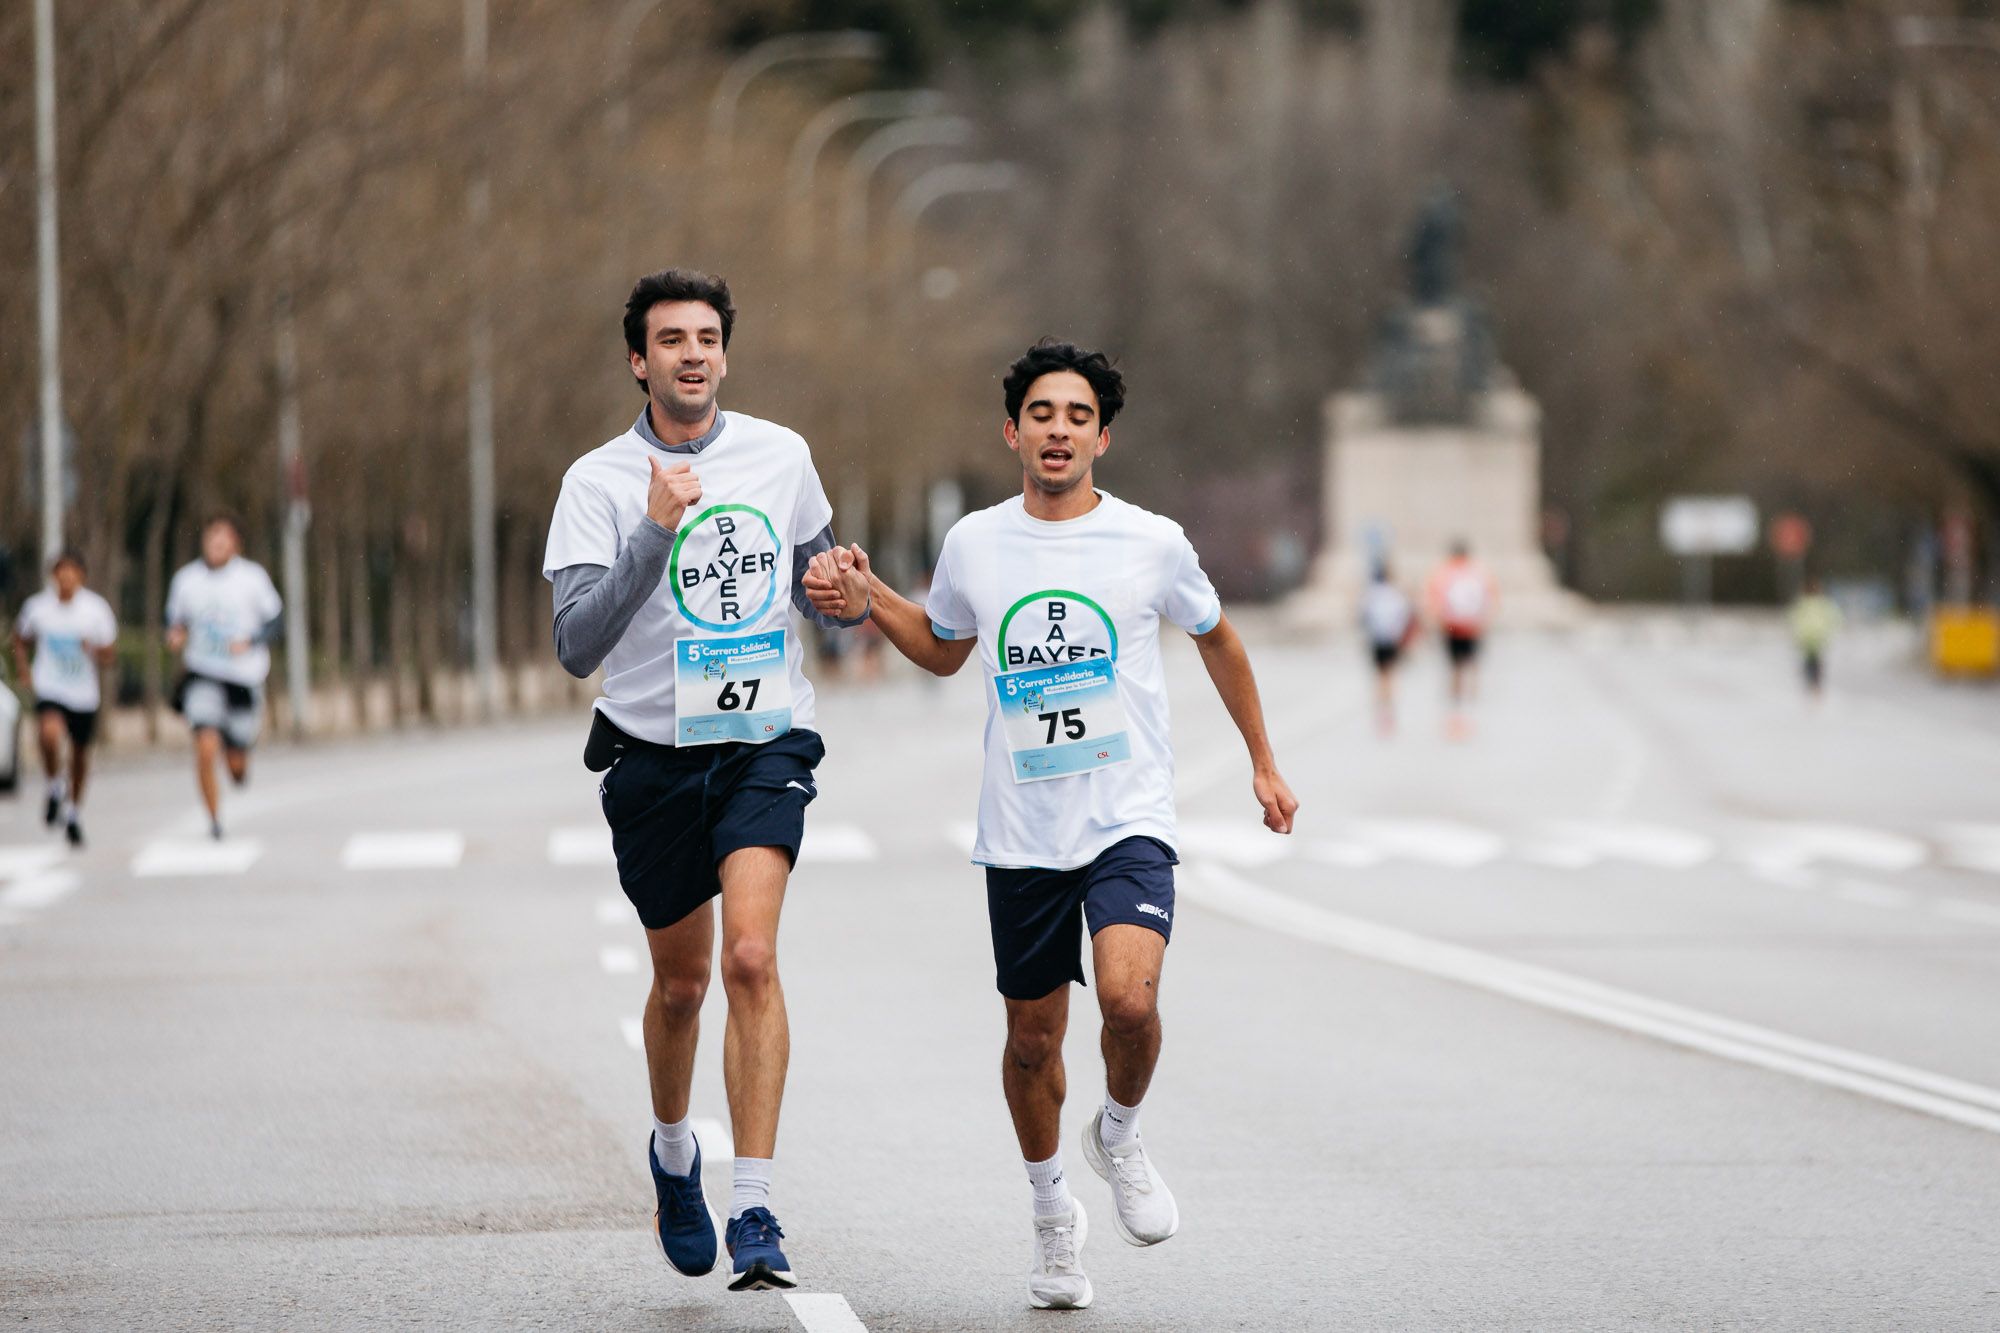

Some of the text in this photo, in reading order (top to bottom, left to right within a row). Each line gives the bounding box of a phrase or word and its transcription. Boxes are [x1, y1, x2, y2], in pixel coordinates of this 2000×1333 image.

[682, 552, 775, 588] BAYER
[715, 516, 741, 621] BAYER
[702, 646, 739, 657] Carrera
[740, 641, 771, 654] Solidaria
[1045, 601, 1066, 662] BAY
[717, 679, 760, 711] 67
[1019, 678, 1053, 689] Carrera
[1054, 669, 1095, 683] Solidaria
[1038, 708, 1086, 744] 75
